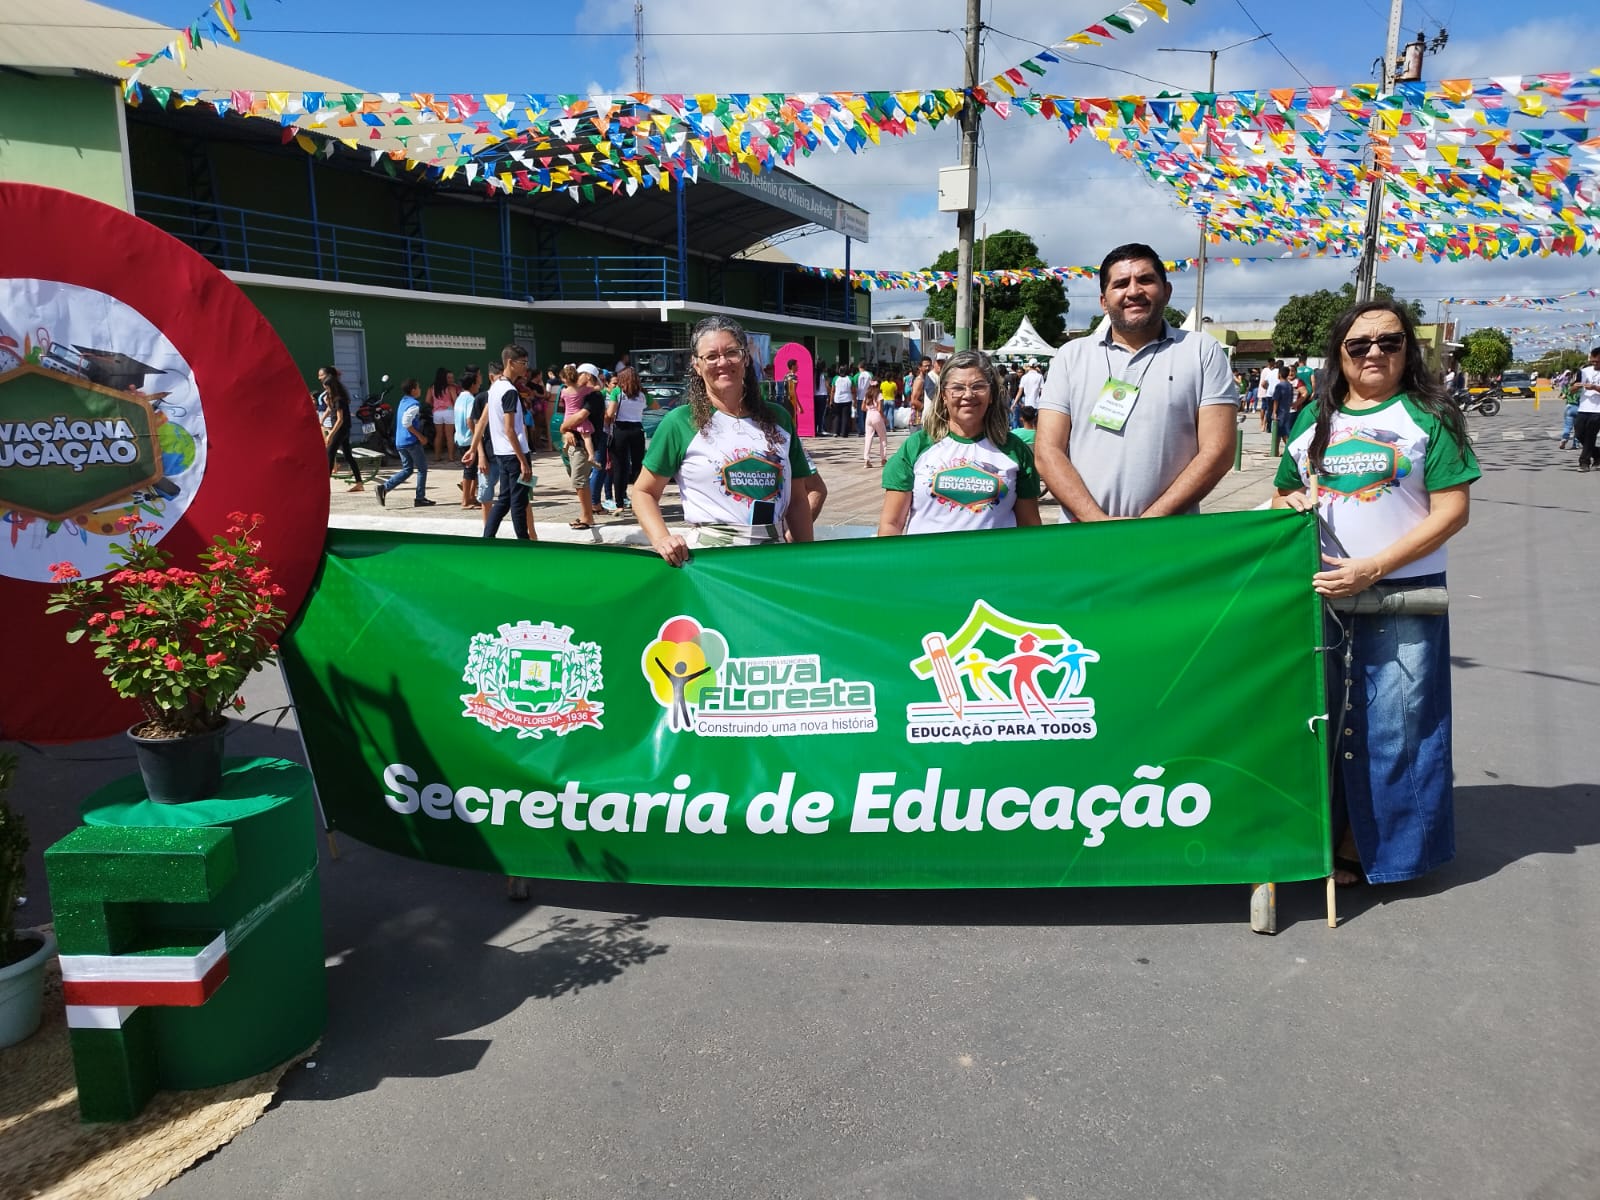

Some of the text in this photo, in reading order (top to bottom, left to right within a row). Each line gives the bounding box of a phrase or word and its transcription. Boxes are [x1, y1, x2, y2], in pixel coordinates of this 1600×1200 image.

[0, 416, 93, 444] VAÇÃO
[0, 436, 137, 471] UCAÇÃO
[1323, 452, 1371, 467] OVAÇÃO
[1323, 461, 1388, 476] UCAÇÃO
[730, 478, 776, 487] EDUCAÇÃO
[938, 481, 994, 493] EDUCAÇÃO
[503, 710, 522, 723] NOVA
[523, 713, 561, 725] FLORESTA
[698, 718, 874, 733] Construindo uma nova história
[911, 723, 1092, 739] EDUCAÇÃO PARA TODOS
[383, 763, 1211, 847] Secretaria de Educação
